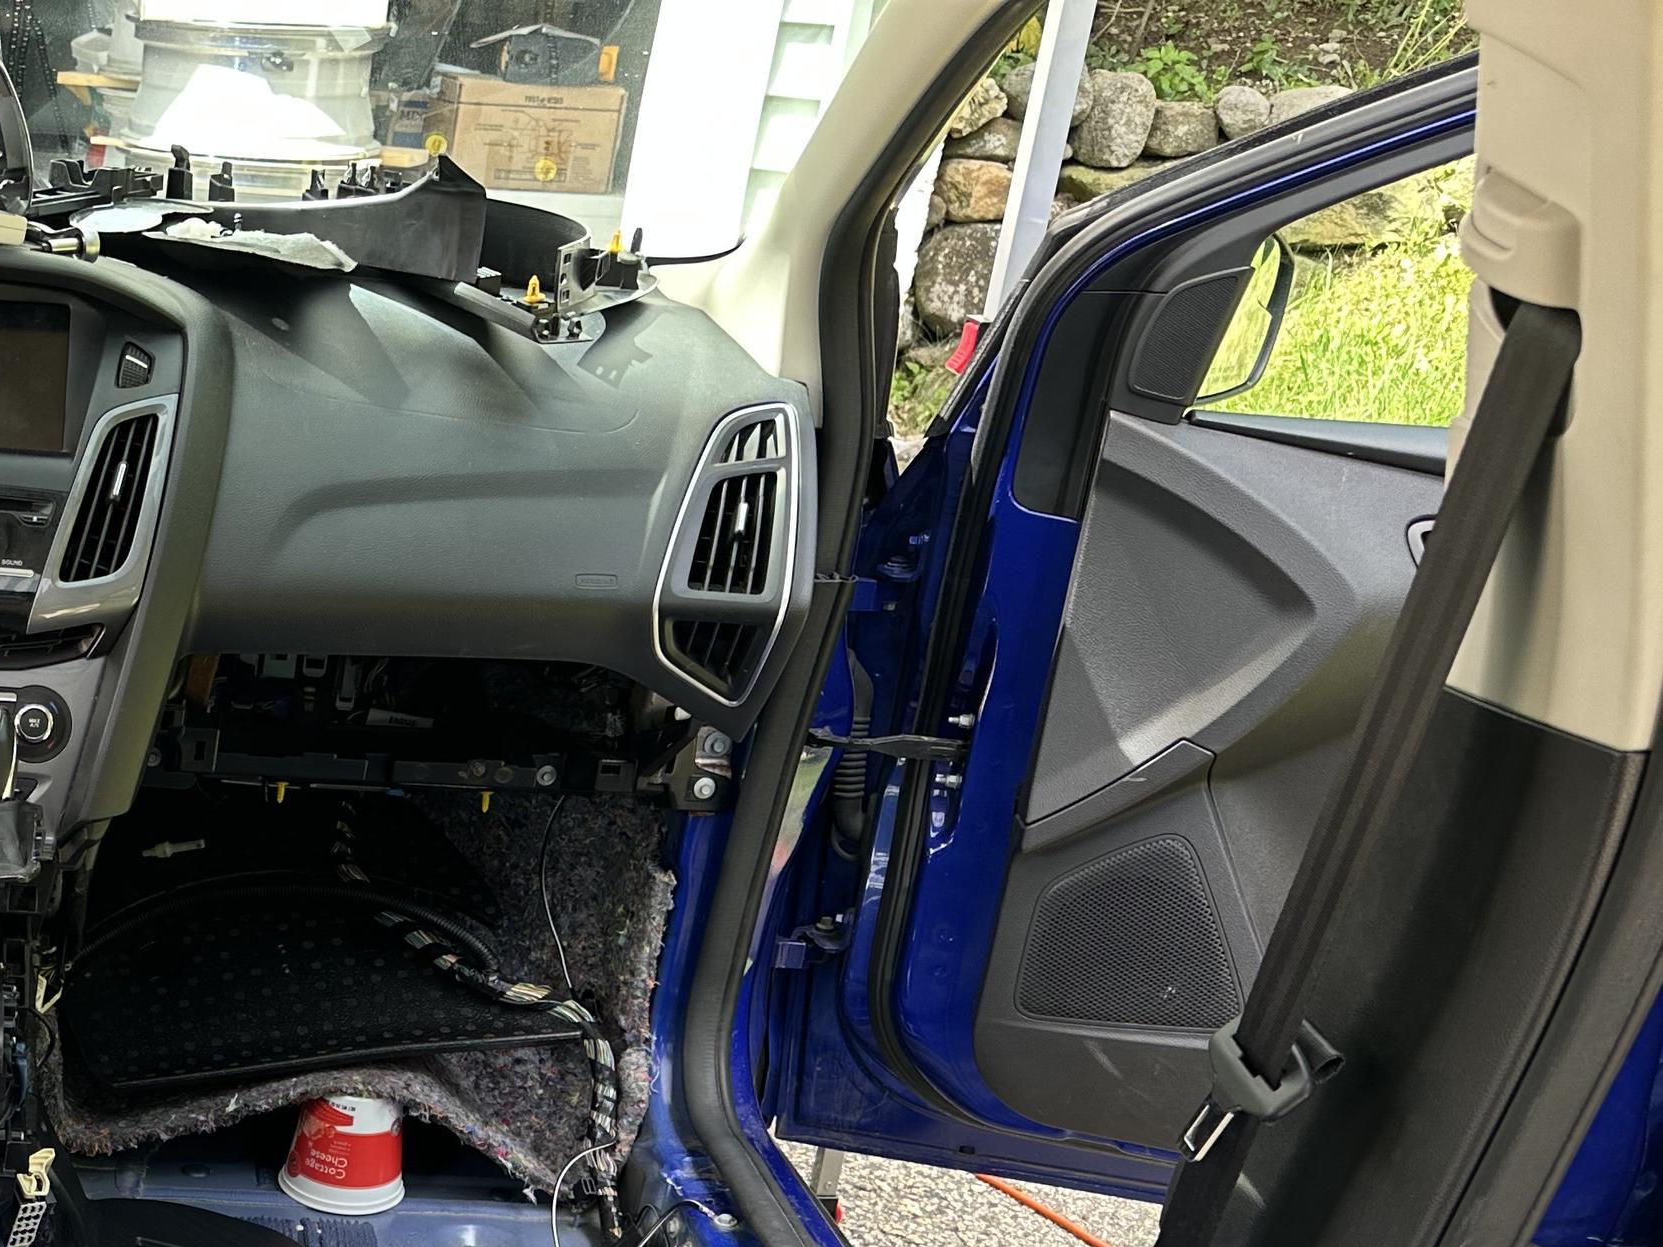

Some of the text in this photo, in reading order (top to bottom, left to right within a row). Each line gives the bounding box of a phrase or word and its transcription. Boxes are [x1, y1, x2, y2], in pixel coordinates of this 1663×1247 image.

[1, 558, 23, 567] SOUND
[310, 1149, 348, 1168] Cheese
[305, 1158, 346, 1180] Cottage
